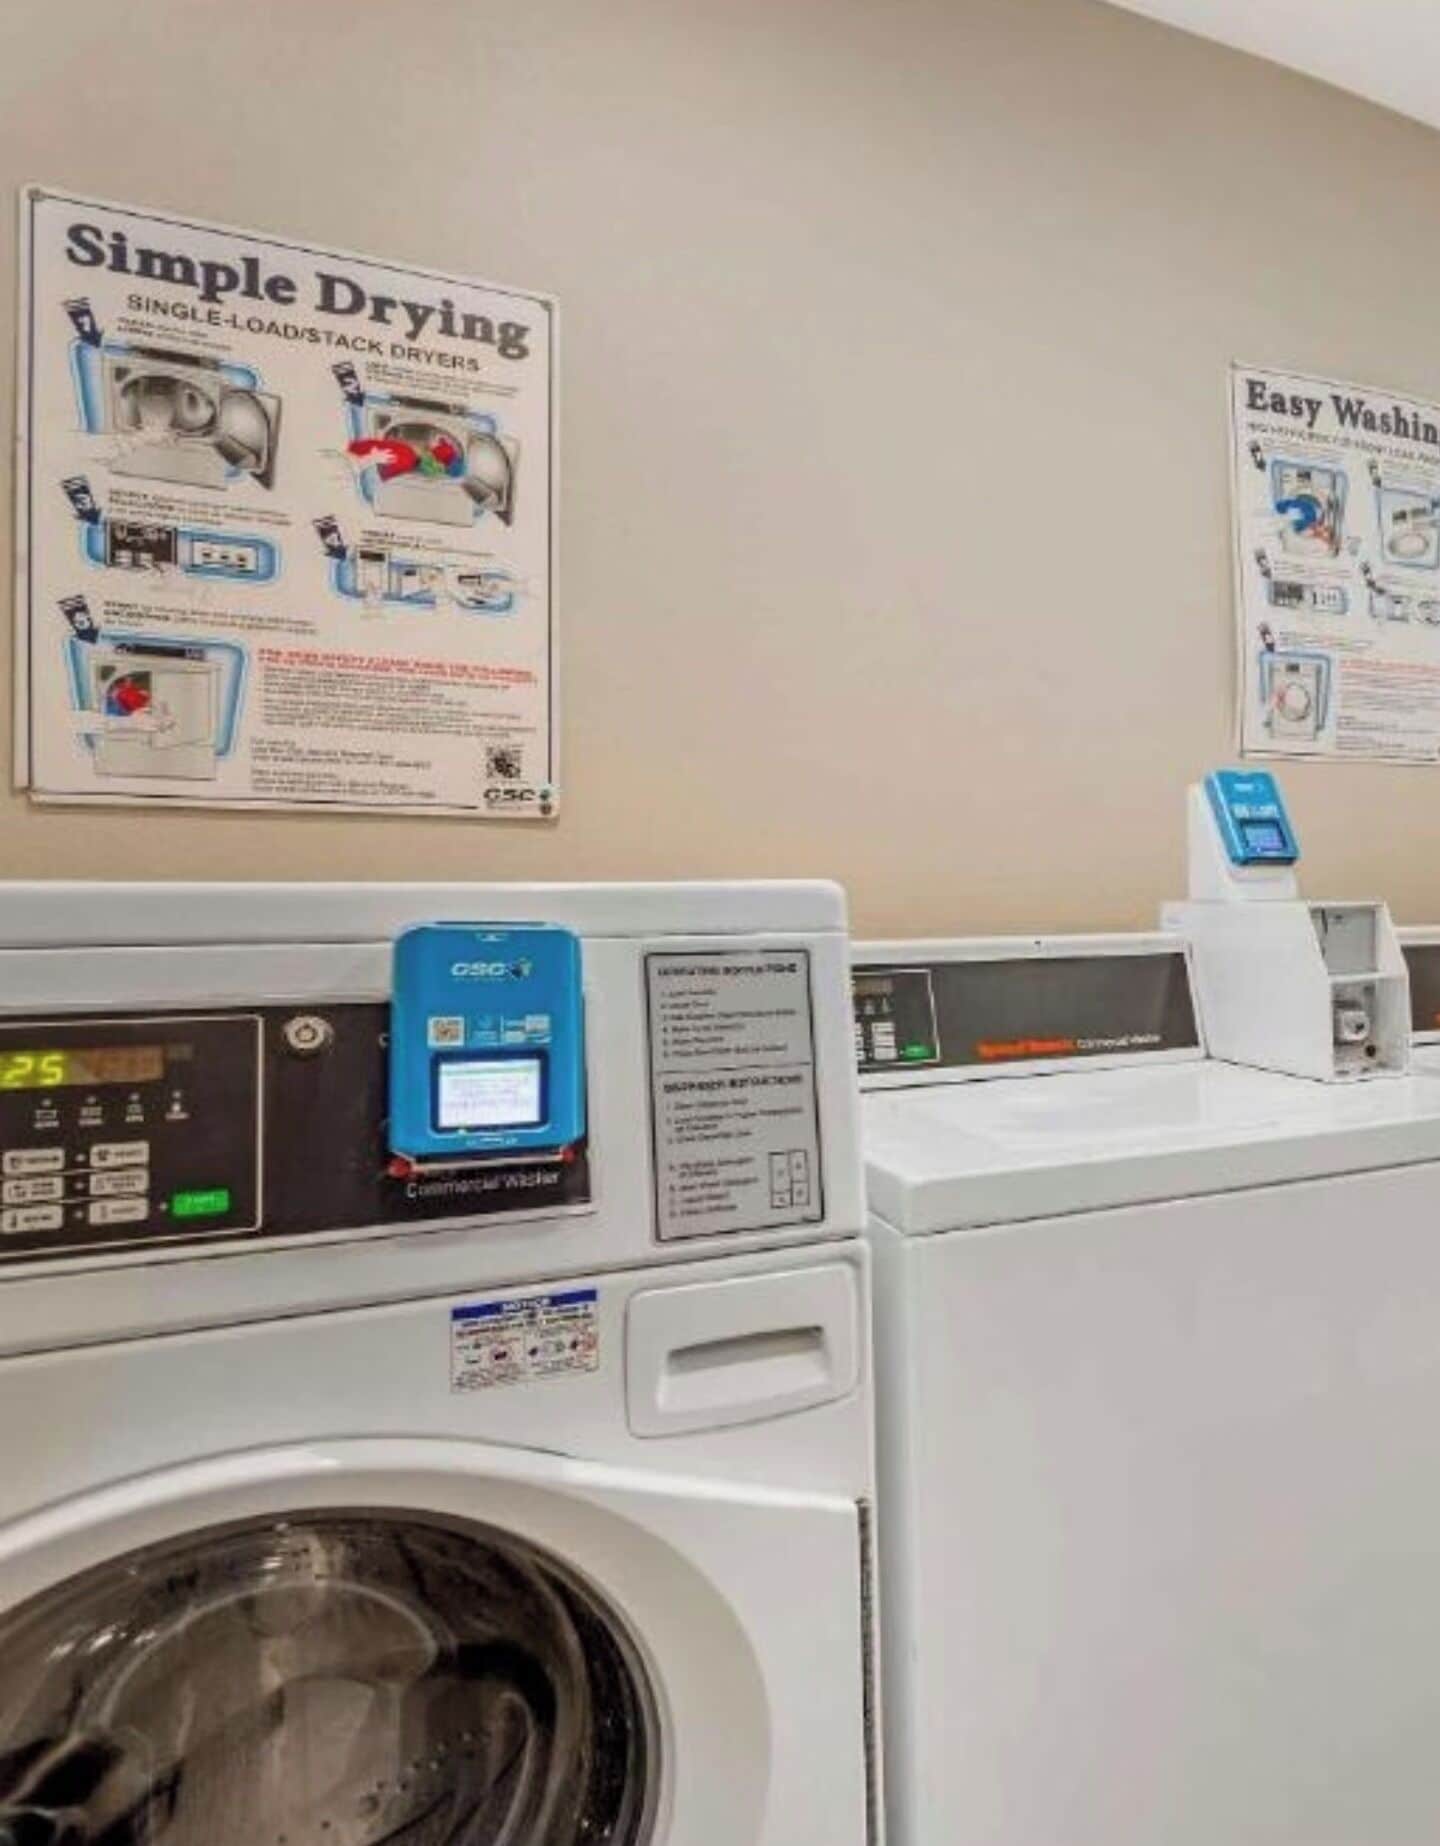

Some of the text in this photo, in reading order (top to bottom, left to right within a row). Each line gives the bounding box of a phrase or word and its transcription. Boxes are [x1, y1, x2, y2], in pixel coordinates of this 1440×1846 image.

[66, 223, 297, 304] Simple
[315, 272, 531, 360] Drying
[127, 294, 383, 355] SINGLE-LOAD/STACK
[390, 344, 480, 371] DRYERS
[1245, 377, 1323, 428] Easy
[3, 1053, 66, 1088] 25
